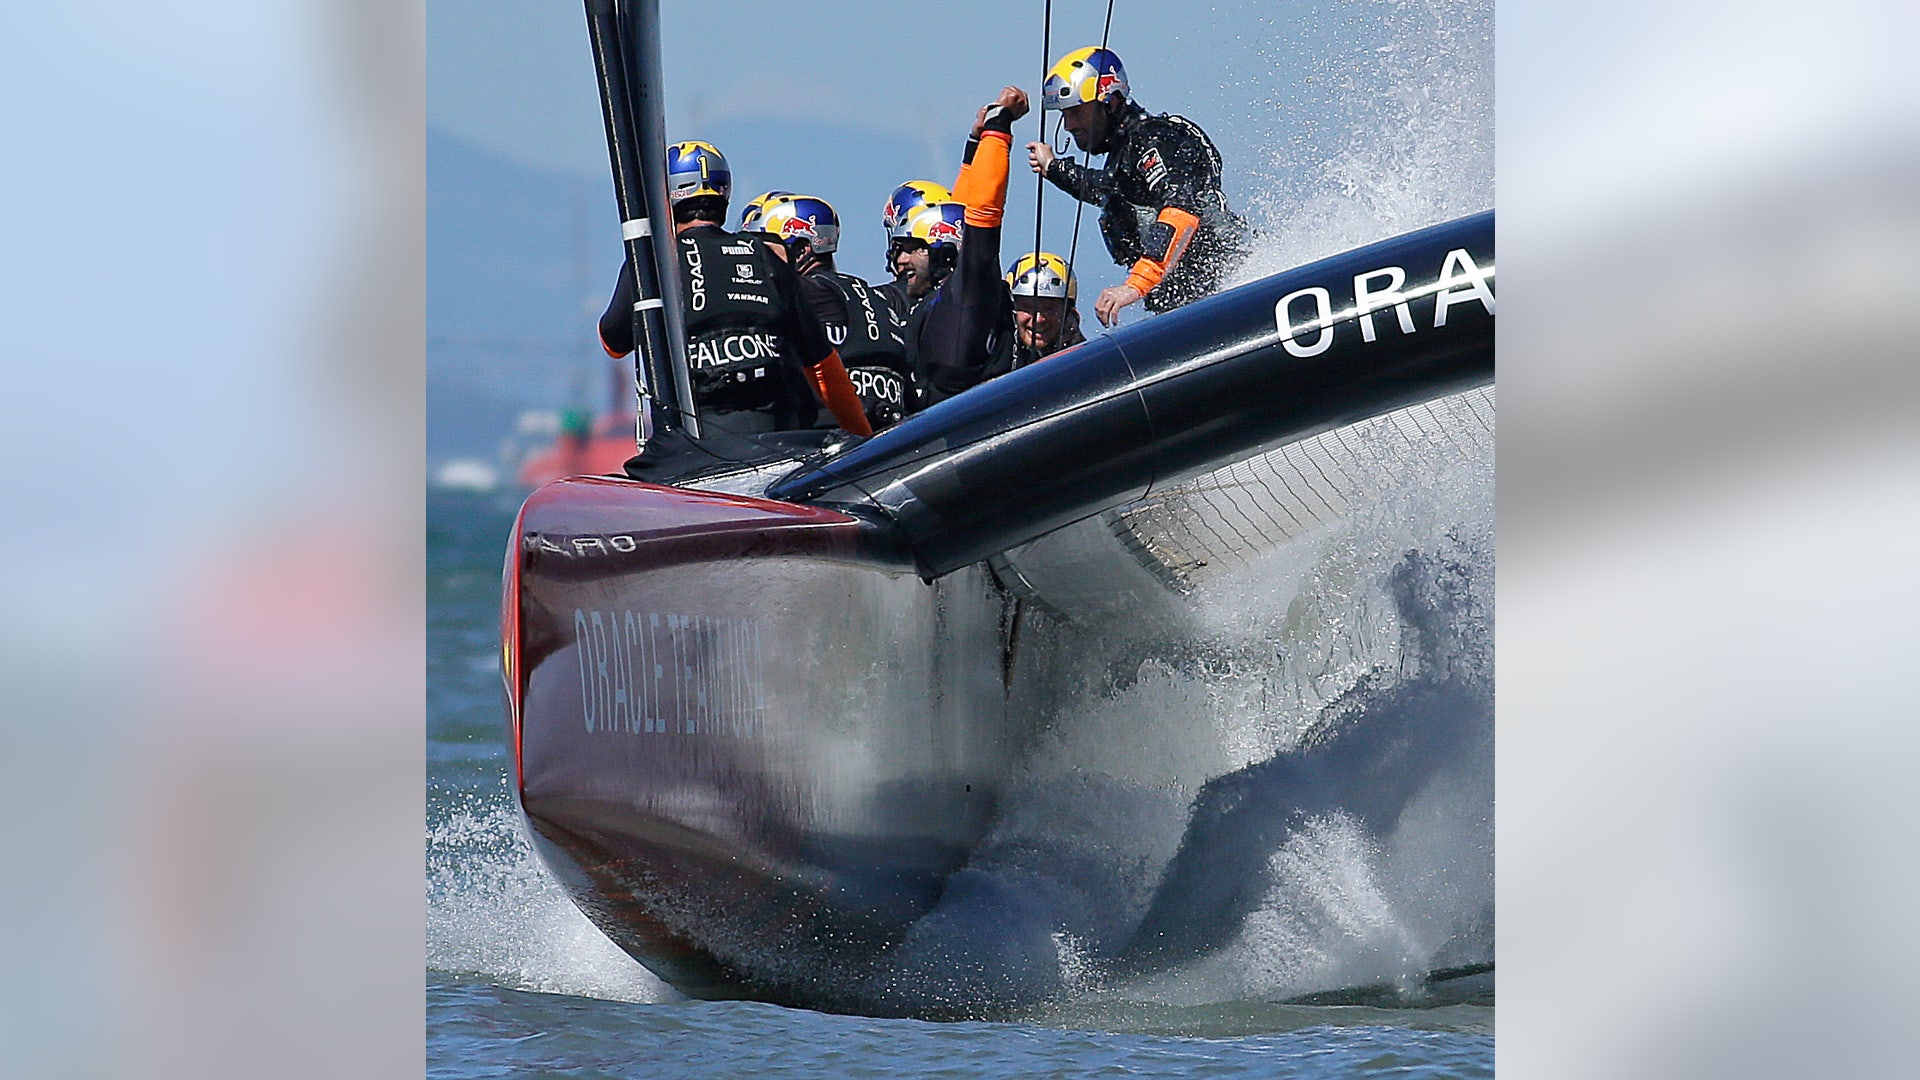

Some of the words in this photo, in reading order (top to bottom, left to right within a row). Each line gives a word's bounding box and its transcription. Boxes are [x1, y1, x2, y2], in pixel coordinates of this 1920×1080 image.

[697, 154, 709, 180] 1
[721, 246, 754, 255] PUMA
[681, 238, 706, 311] ORACLE
[726, 293, 769, 304] YANMAR
[574, 608, 666, 735] ORACLE
[666, 613, 726, 736] TEAM
